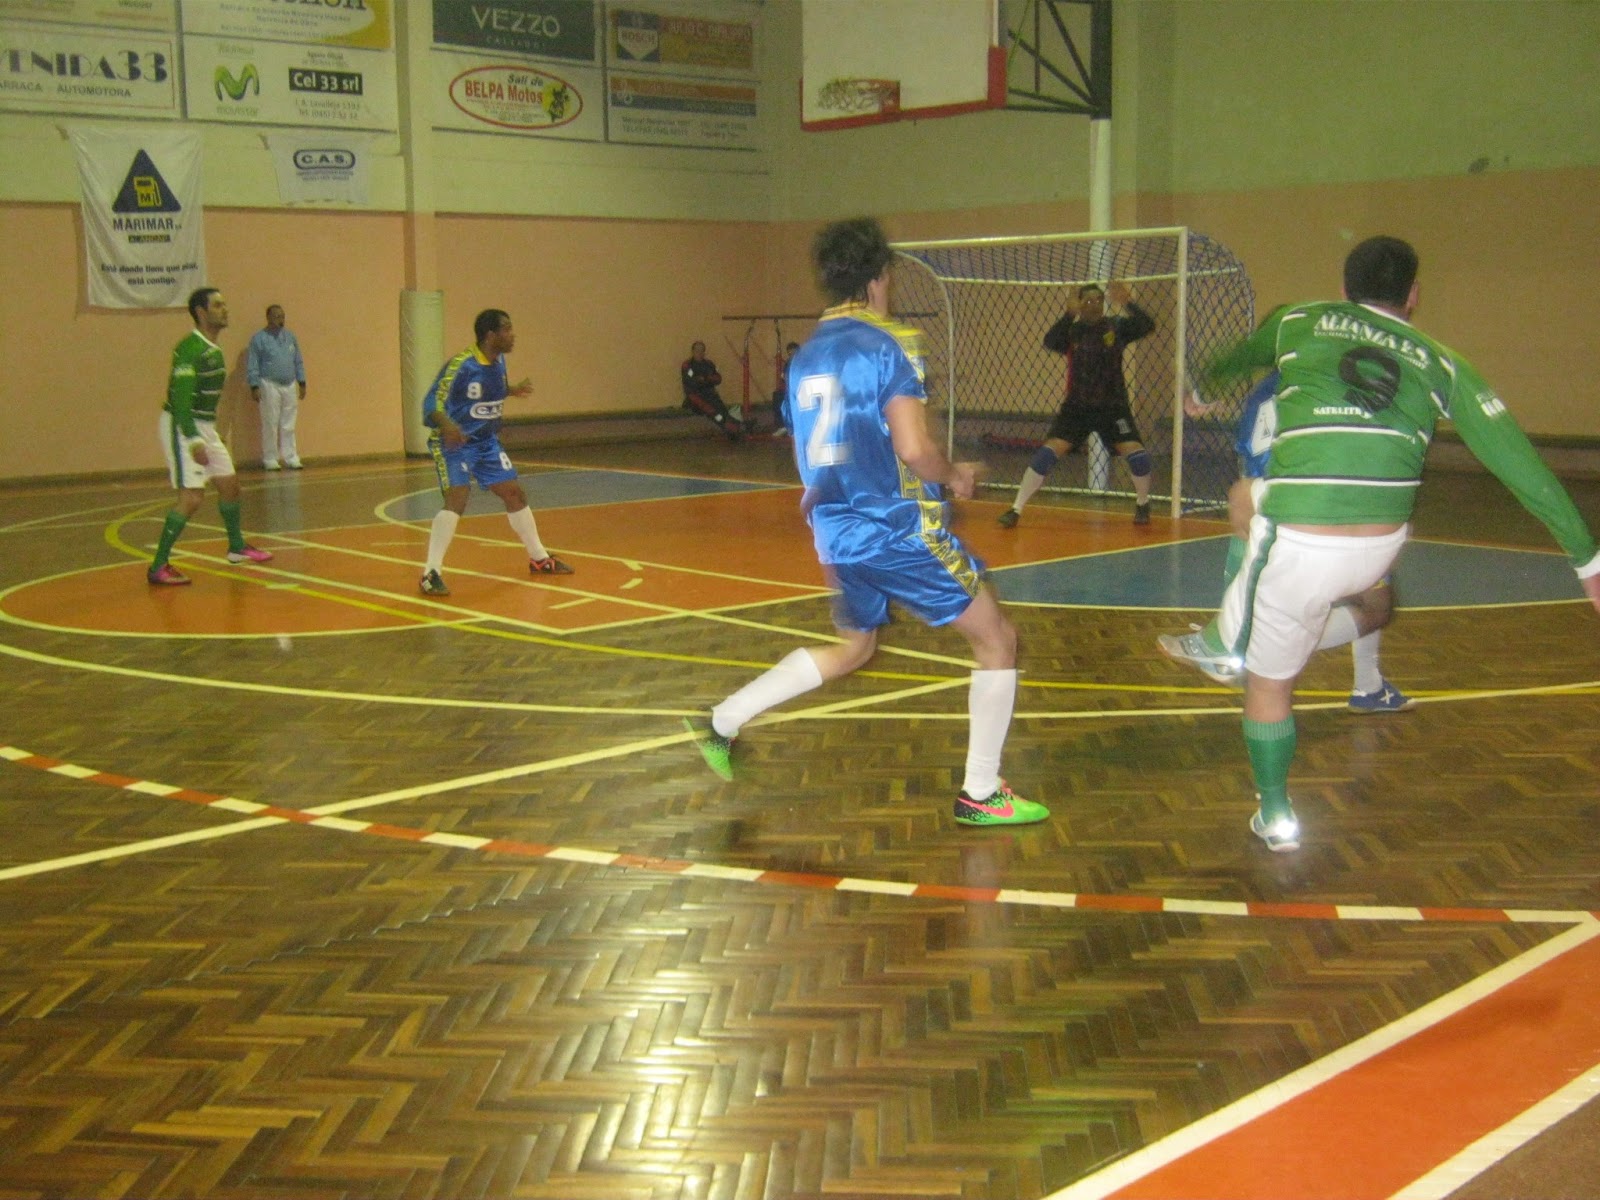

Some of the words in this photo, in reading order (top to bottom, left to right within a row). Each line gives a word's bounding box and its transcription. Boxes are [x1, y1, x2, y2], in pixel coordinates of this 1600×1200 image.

[472, 5, 560, 37] VEZZO
[57, 84, 132, 97] AUTOMOTORA
[293, 71, 316, 88] Cel
[321, 75, 338, 91] 33
[343, 77, 359, 91] srl
[464, 79, 504, 100] BELPA
[508, 85, 543, 102] Motos
[531, 76, 544, 87] de
[140, 193, 151, 202] M
[113, 217, 174, 231] MARIMAR
[119, 265, 143, 273] donde
[166, 265, 180, 273] que
[1314, 314, 1397, 350] ALIANZA
[1339, 346, 1400, 412] 9
[467, 382, 482, 399] 8
[797, 373, 853, 470] 2
[499, 451, 512, 471] 8
